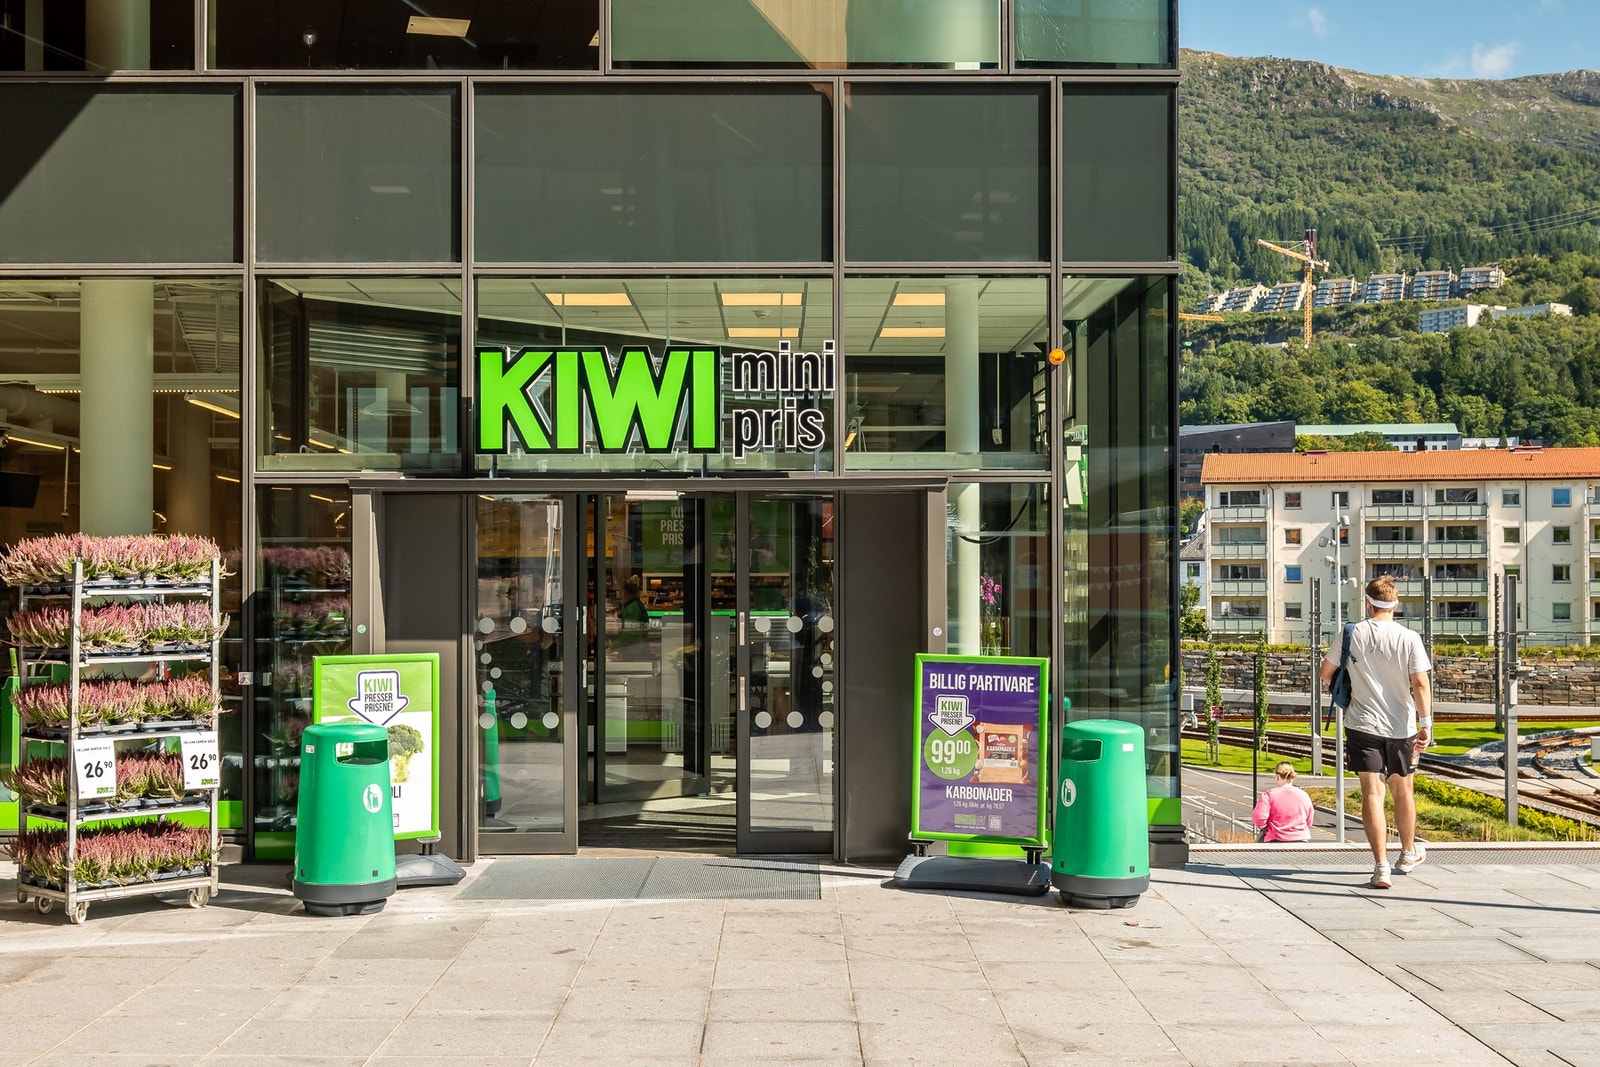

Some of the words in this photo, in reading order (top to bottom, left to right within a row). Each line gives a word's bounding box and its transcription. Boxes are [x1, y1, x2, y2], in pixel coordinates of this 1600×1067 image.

[731, 340, 835, 392] mini
[476, 346, 721, 453] KIWI
[731, 398, 825, 459] pris
[364, 678, 393, 693] KIWI
[929, 673, 967, 690] BILLIG
[969, 675, 1035, 693] PARTIVARE
[364, 692, 393, 703] PRESSER
[941, 700, 963, 711] KIWI
[364, 702, 394, 713] PRISENE!
[953, 767, 960, 776] kg
[945, 785, 1013, 802] KARBONADER
